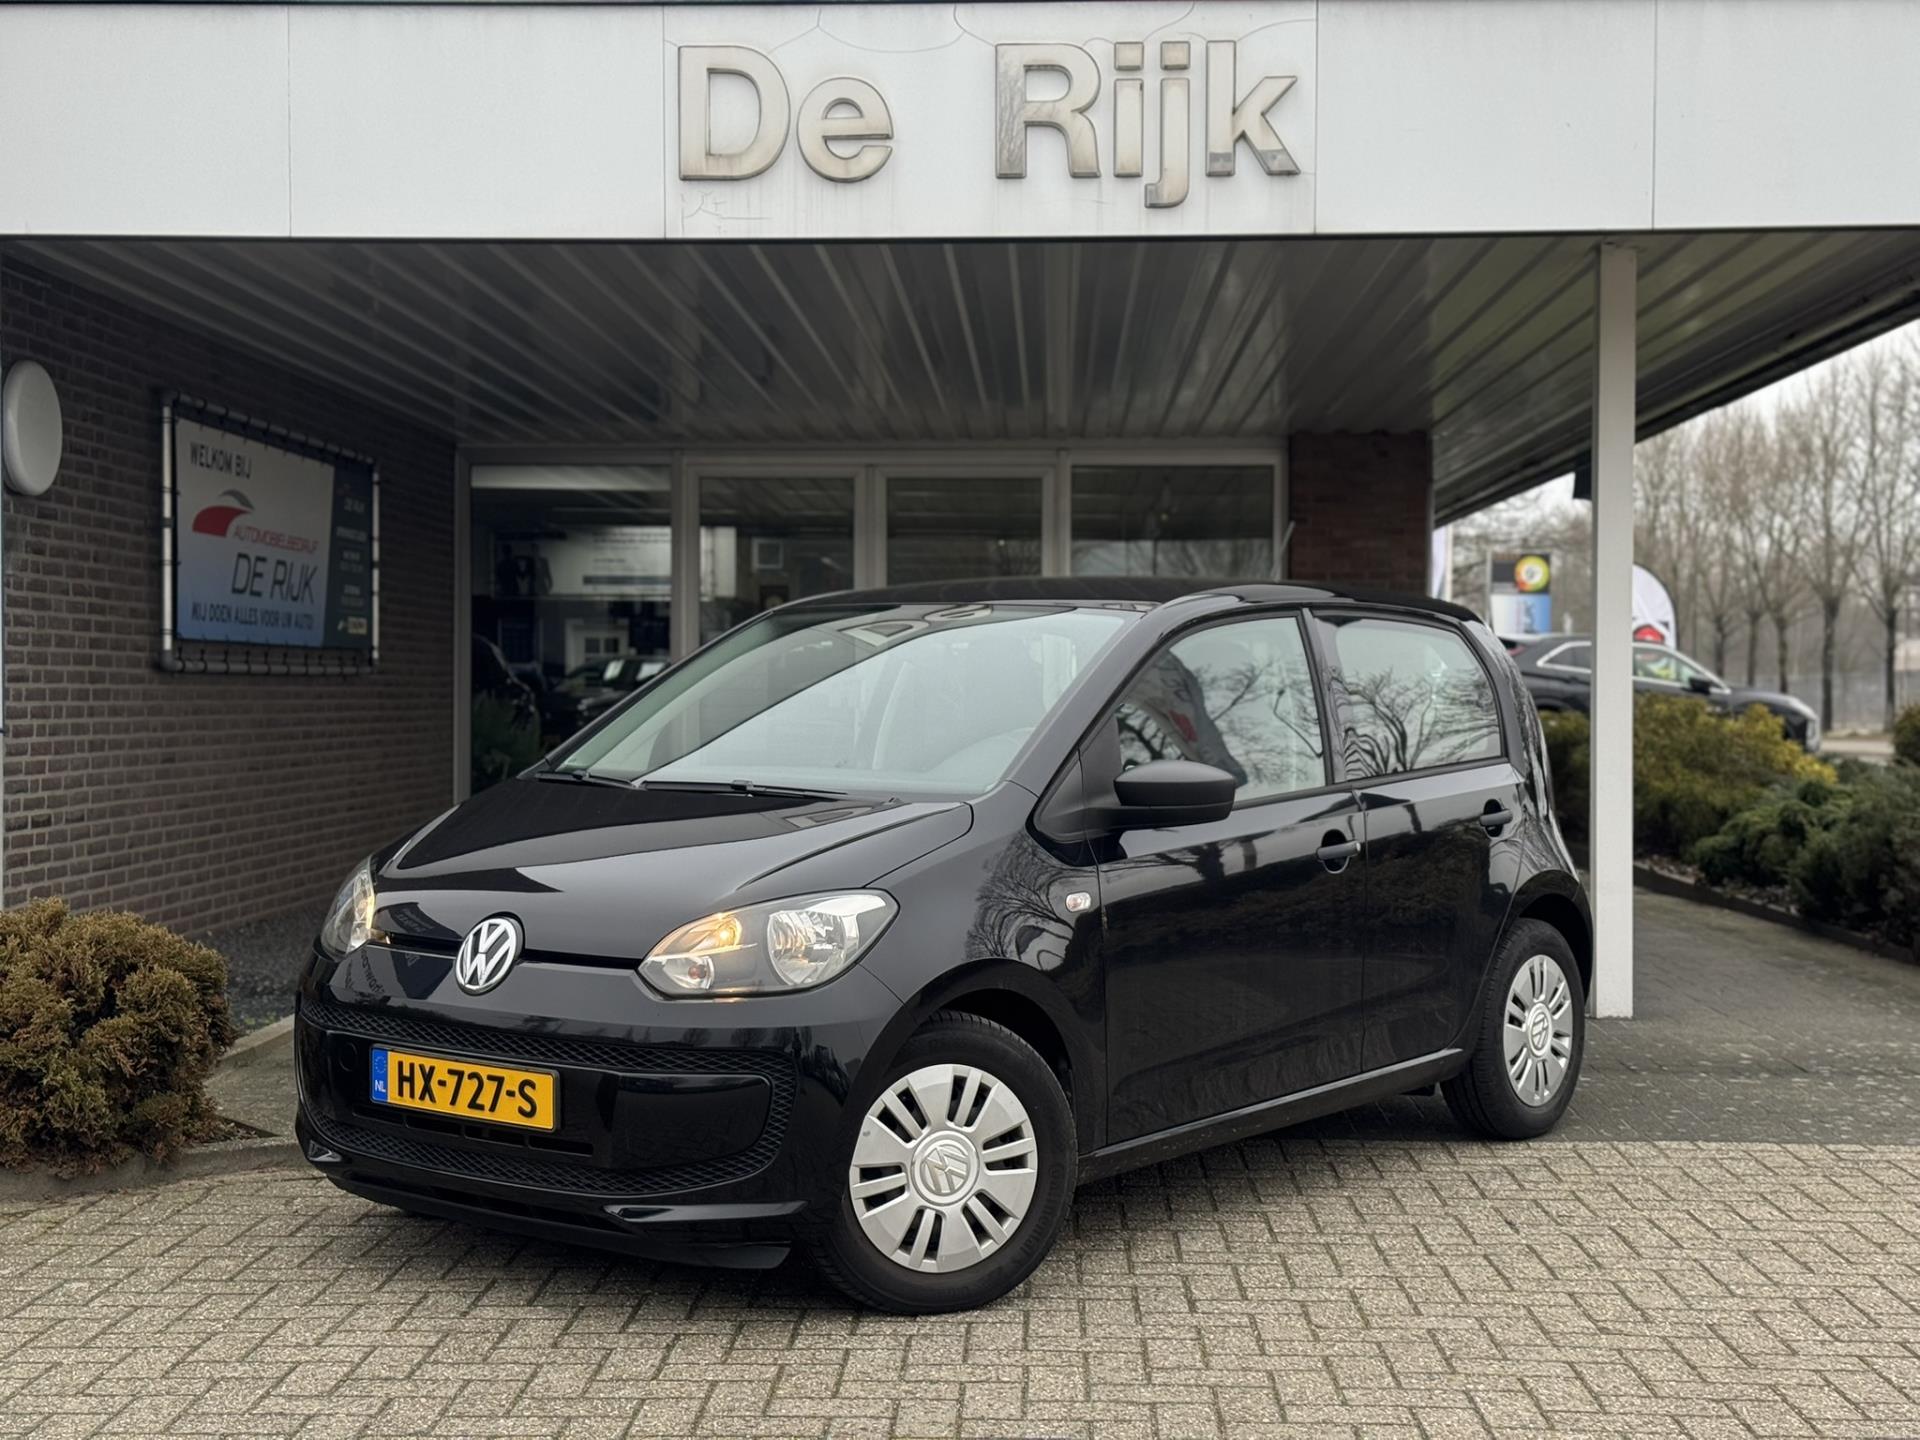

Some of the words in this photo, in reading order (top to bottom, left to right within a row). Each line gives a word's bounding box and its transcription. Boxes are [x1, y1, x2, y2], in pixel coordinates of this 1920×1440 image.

[677, 44, 894, 183] De
[994, 40, 1300, 209] Rijk
[190, 441, 232, 474] WELKOM
[235, 454, 252, 479] BIJ
[231, 552, 268, 597] DE
[269, 559, 319, 605] RIJK
[191, 602, 207, 622] WIJ
[208, 603, 232, 624] DOEN
[234, 607, 259, 626] ALLES
[261, 609, 280, 628] VOOR
[374, 1079, 387, 1093] NL
[396, 1059, 538, 1119] HX-727-S
